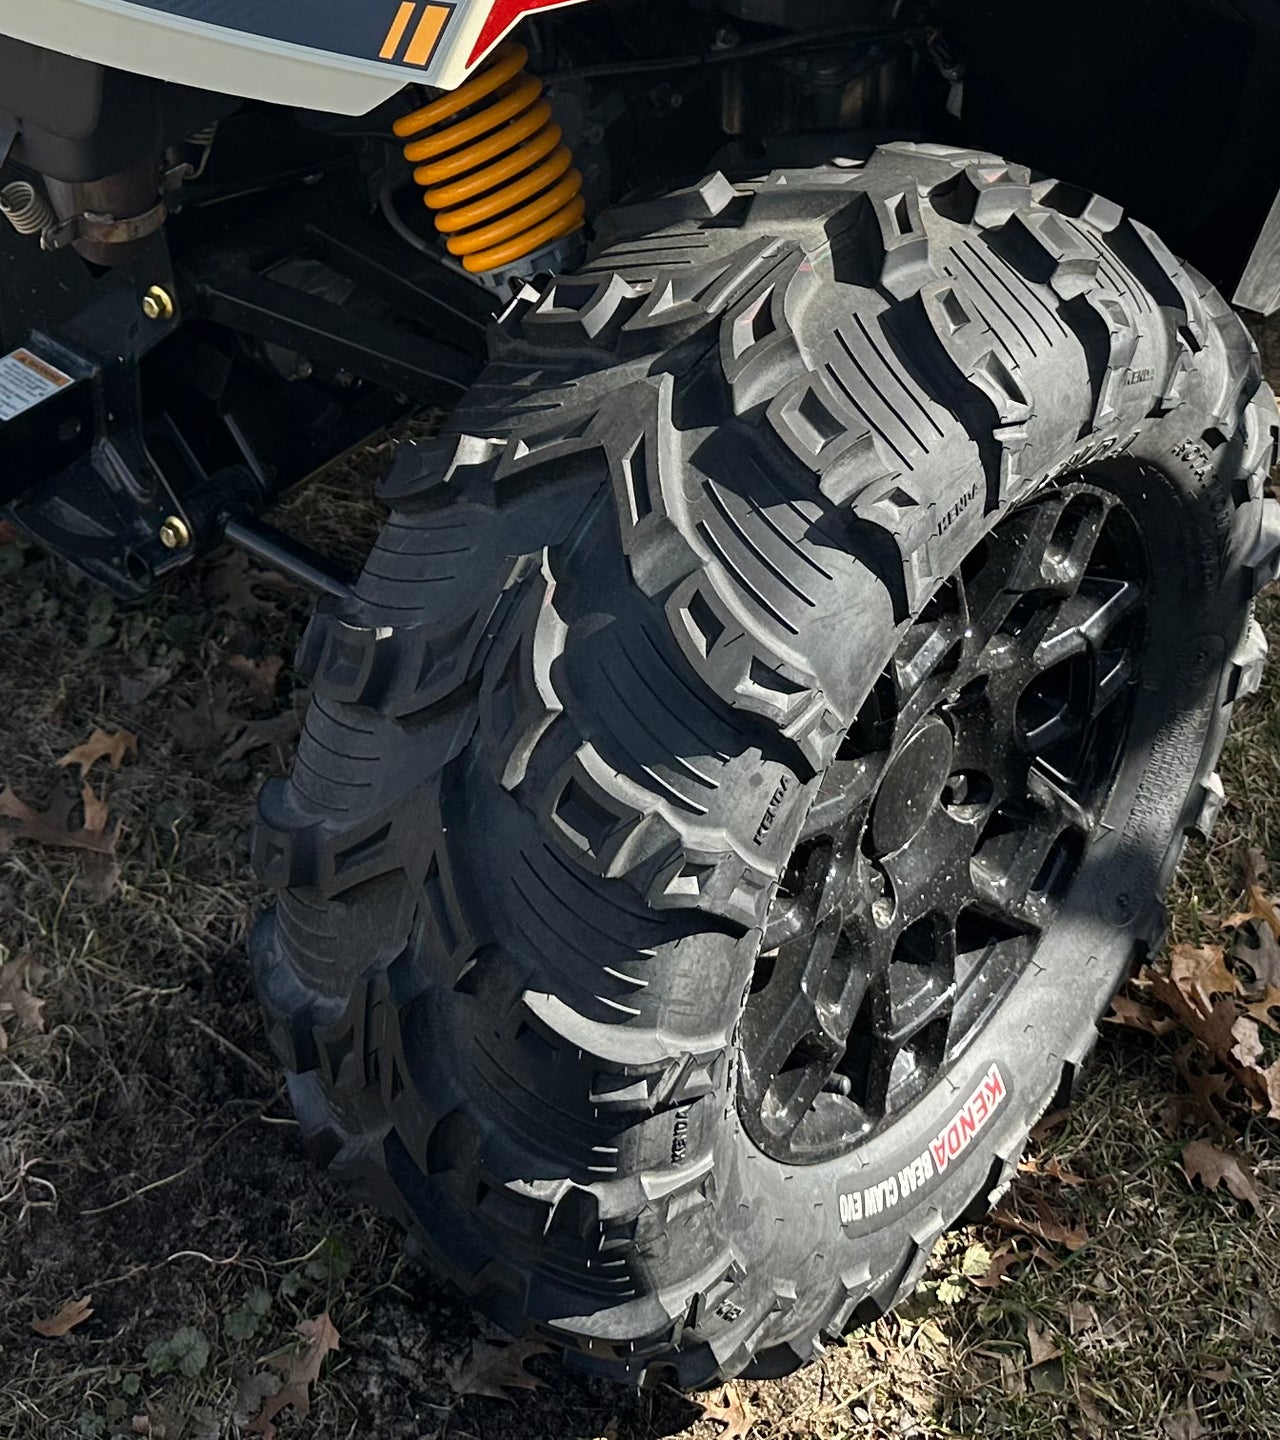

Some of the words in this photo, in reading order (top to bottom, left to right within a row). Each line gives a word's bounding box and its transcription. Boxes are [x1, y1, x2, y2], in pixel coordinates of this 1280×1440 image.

[753, 774, 791, 847] KENDA
[928, 1062, 1007, 1174] KENDA
[864, 1175, 899, 1218] CLAW
[897, 1149, 935, 1198] BEAR
[839, 1190, 863, 1223] EVO
